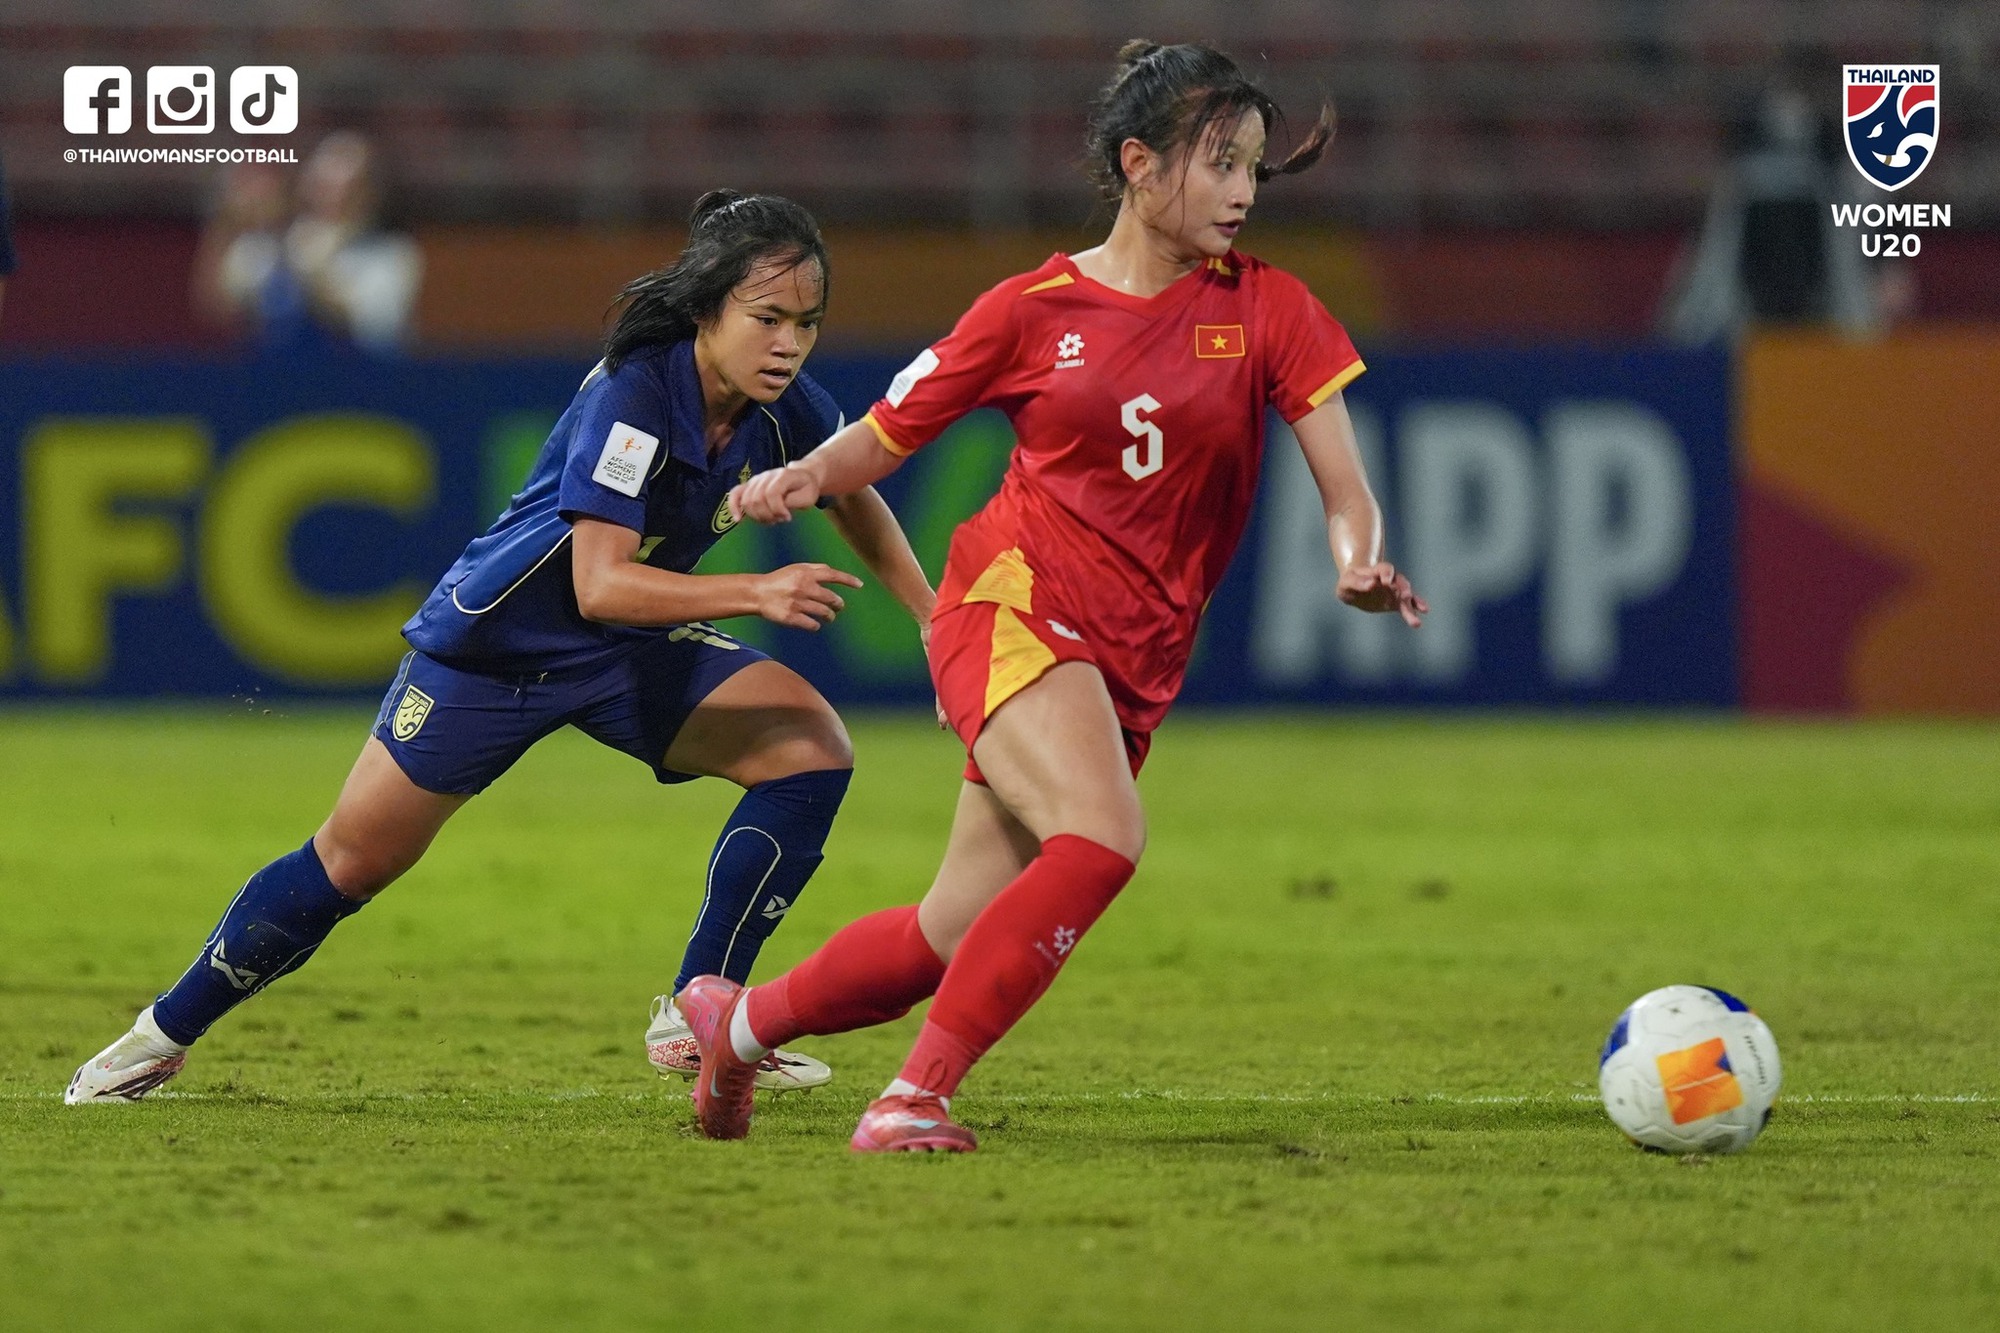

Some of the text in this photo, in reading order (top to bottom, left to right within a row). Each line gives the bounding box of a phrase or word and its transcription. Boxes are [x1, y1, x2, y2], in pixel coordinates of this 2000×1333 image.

[610, 456, 623, 465] AFC
[602, 465, 621, 475] ASIAN
[622, 473, 636, 481] CUP
[0, 413, 432, 688] FC
[1255, 402, 1694, 685] APP
